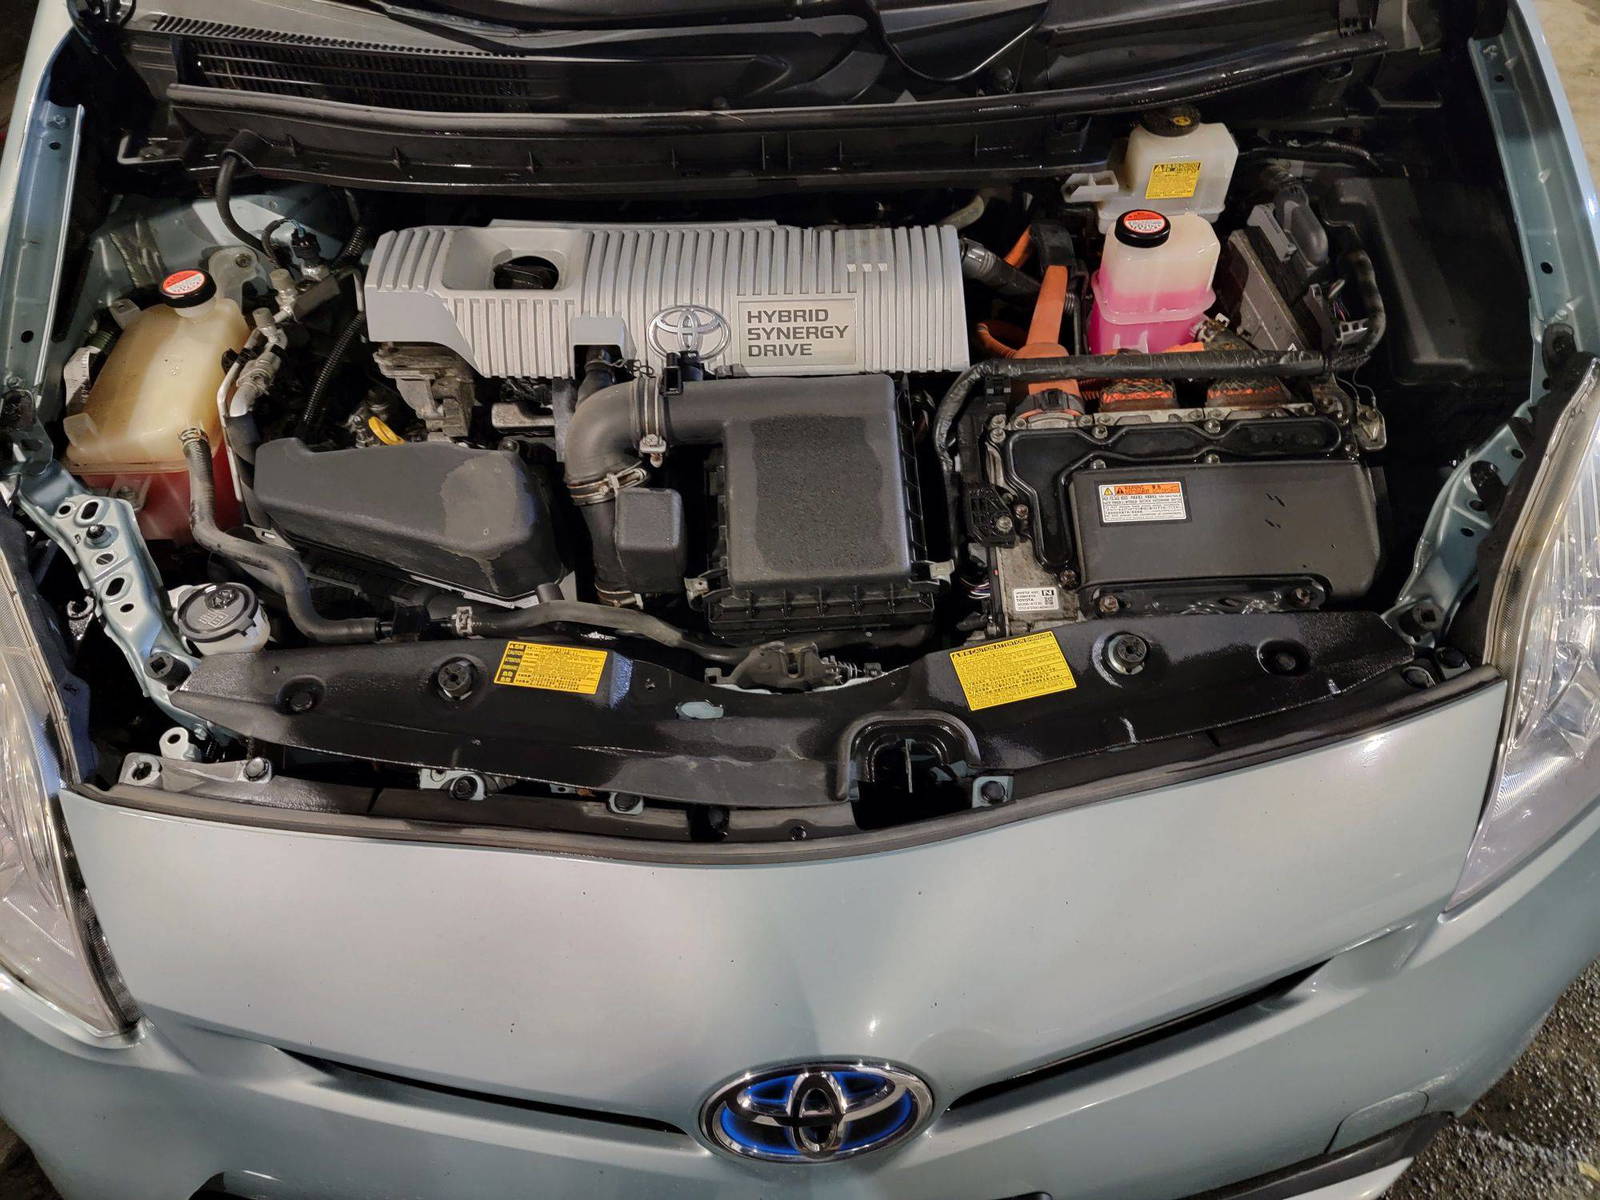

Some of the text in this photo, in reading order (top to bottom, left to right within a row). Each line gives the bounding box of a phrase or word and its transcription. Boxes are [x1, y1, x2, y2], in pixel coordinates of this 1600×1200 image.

[747, 309, 829, 323] HYBRID
[747, 325, 849, 341] SYNERGY
[748, 343, 813, 357] DRIVE
